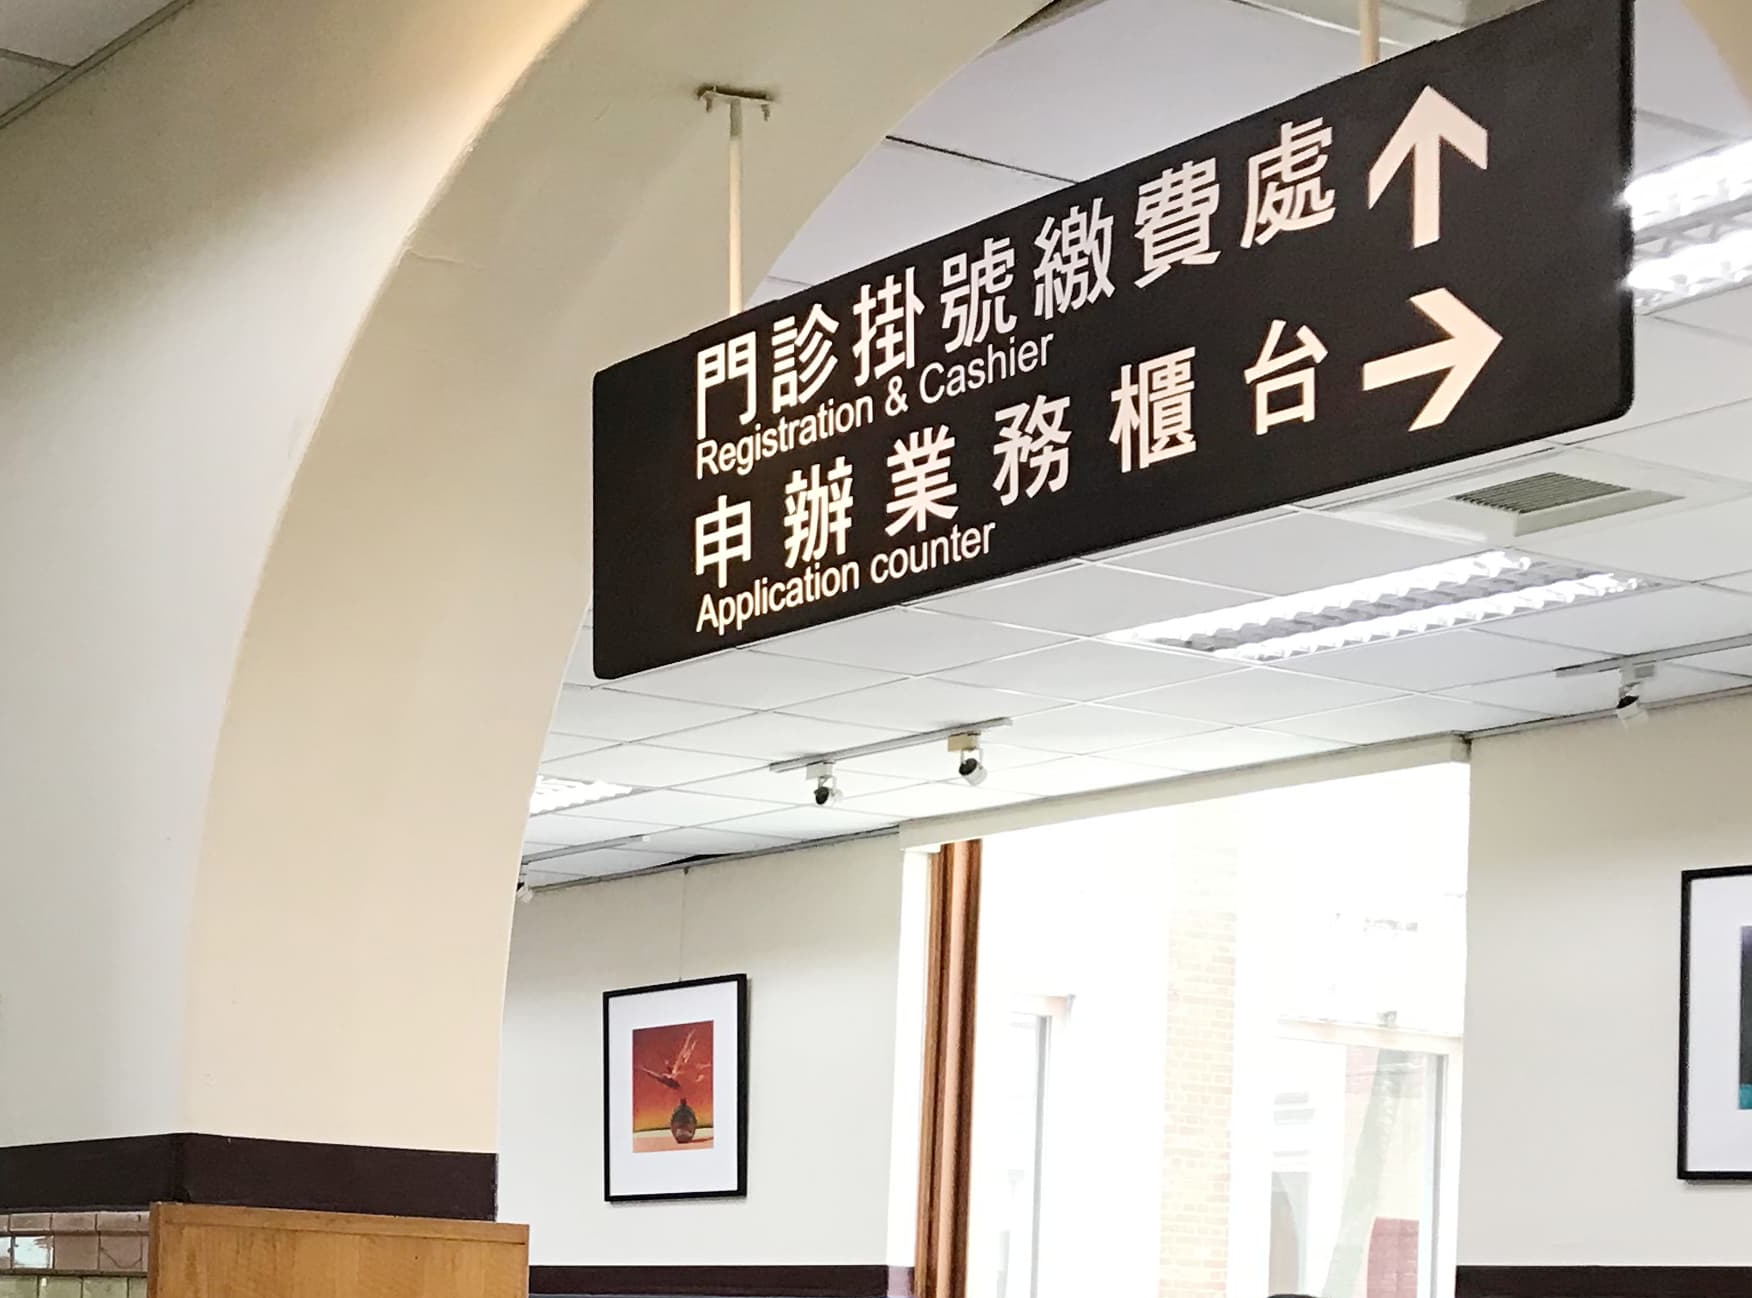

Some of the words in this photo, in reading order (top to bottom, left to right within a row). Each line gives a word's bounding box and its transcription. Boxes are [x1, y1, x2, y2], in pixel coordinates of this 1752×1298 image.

[694, 115, 1337, 440] 門診掛號繳費處
[692, 318, 1330, 591] 申辦業務櫃台
[696, 393, 875, 479] Registration
[884, 378, 910, 415] &
[918, 326, 1055, 406] Cashier
[696, 562, 860, 633] Application
[870, 519, 996, 584] counter
